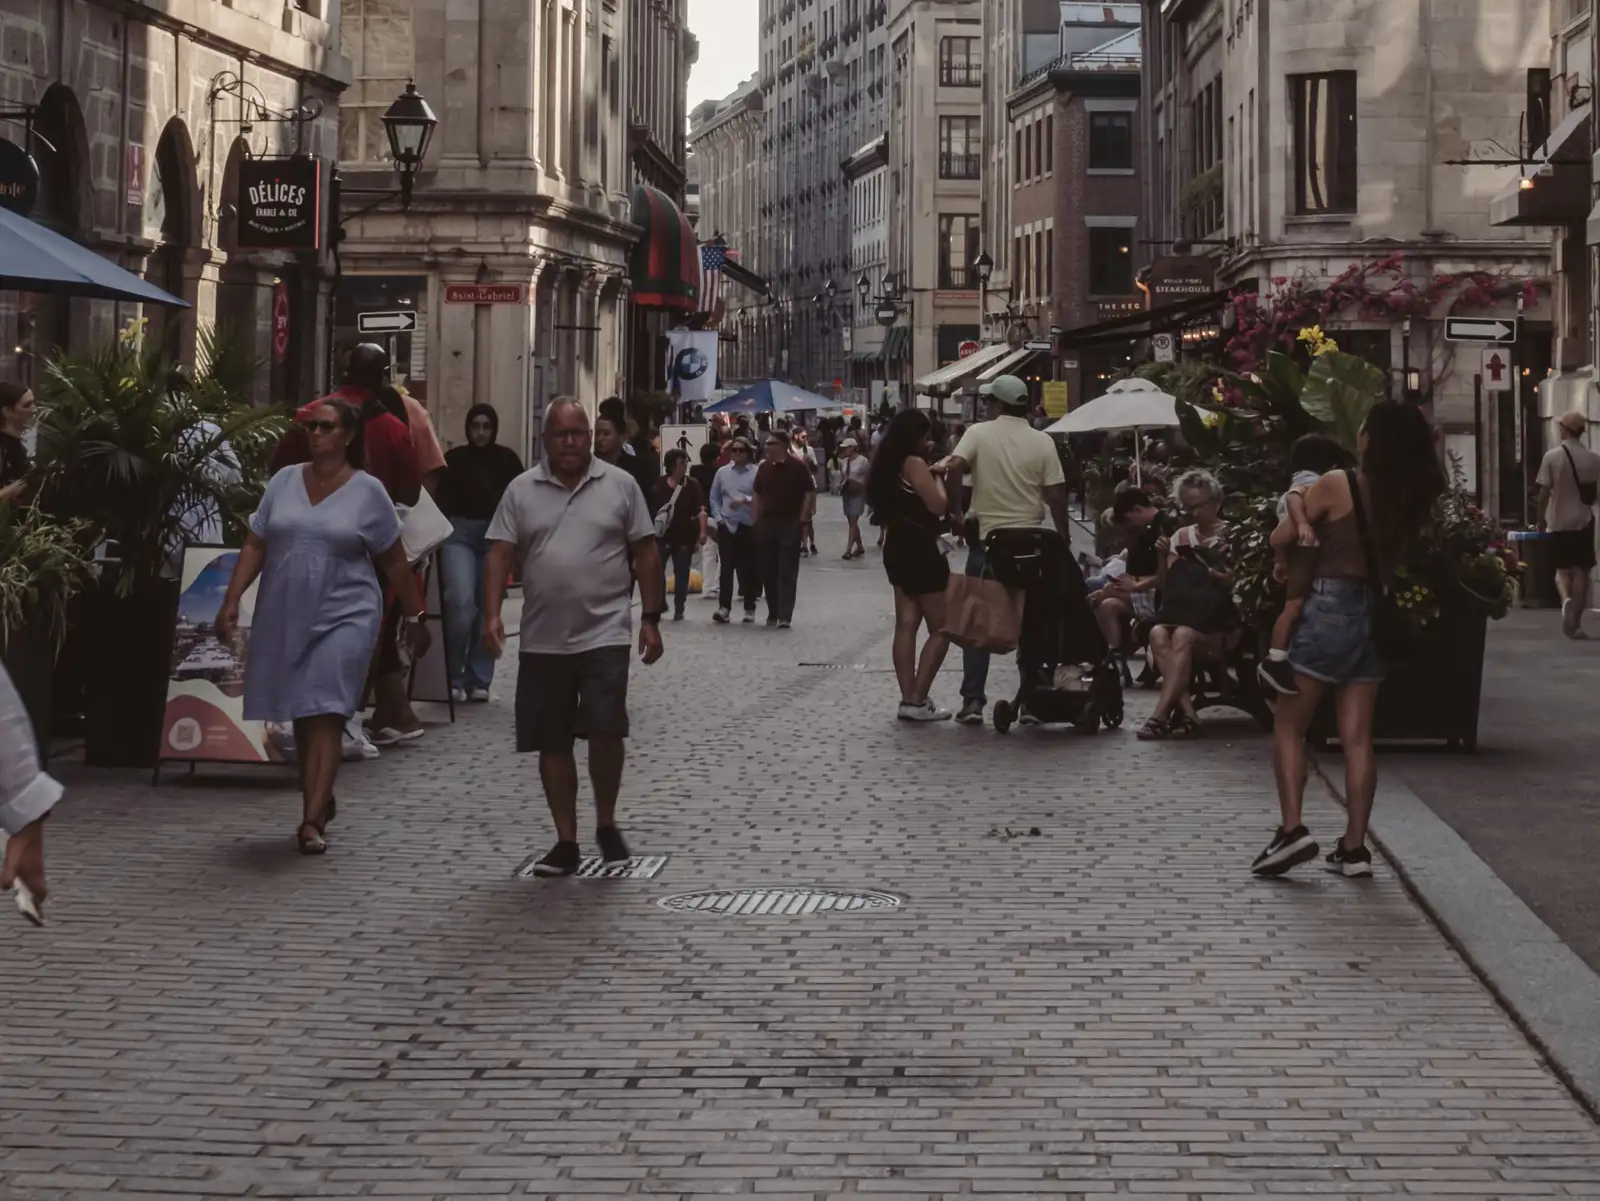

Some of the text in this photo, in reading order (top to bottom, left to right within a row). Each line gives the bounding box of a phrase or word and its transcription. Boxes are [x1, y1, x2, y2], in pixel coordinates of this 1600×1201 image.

[249, 179, 306, 205] DÉLICES
[1155, 285, 1211, 293] STEAKHOUSE
[451, 290, 515, 300] Saint-Gabriel
